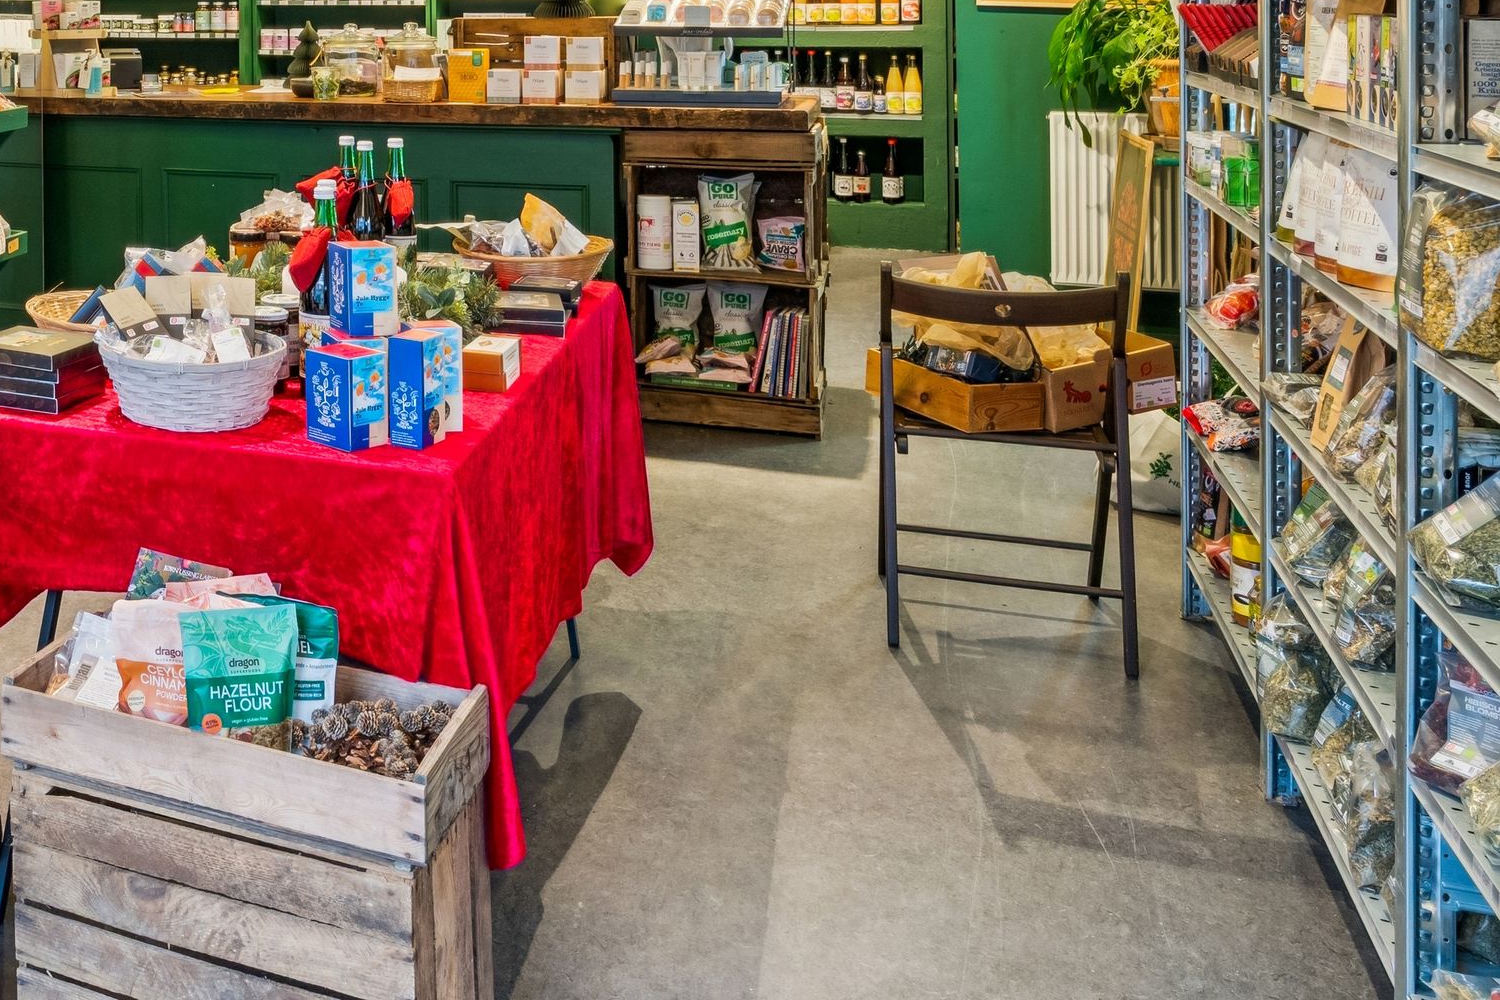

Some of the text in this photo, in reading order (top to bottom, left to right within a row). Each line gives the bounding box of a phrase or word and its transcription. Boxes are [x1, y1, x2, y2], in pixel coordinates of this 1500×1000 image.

[1473, 80, 1498, 88] 1000
[710, 183, 735, 194] GO
[711, 191, 735, 200] PURE
[706, 225, 746, 243] rosemary
[355, 294, 391, 304] Jule Hygge
[662, 291, 686, 303] GO
[723, 292, 748, 304] GO
[355, 301, 364, 309] Te
[662, 301, 686, 309] PURE
[724, 301, 748, 310] PURE
[228, 657, 260, 670] dragon
[209, 680, 284, 700] HAZELNUT
[224, 696, 273, 714] FLOUR
